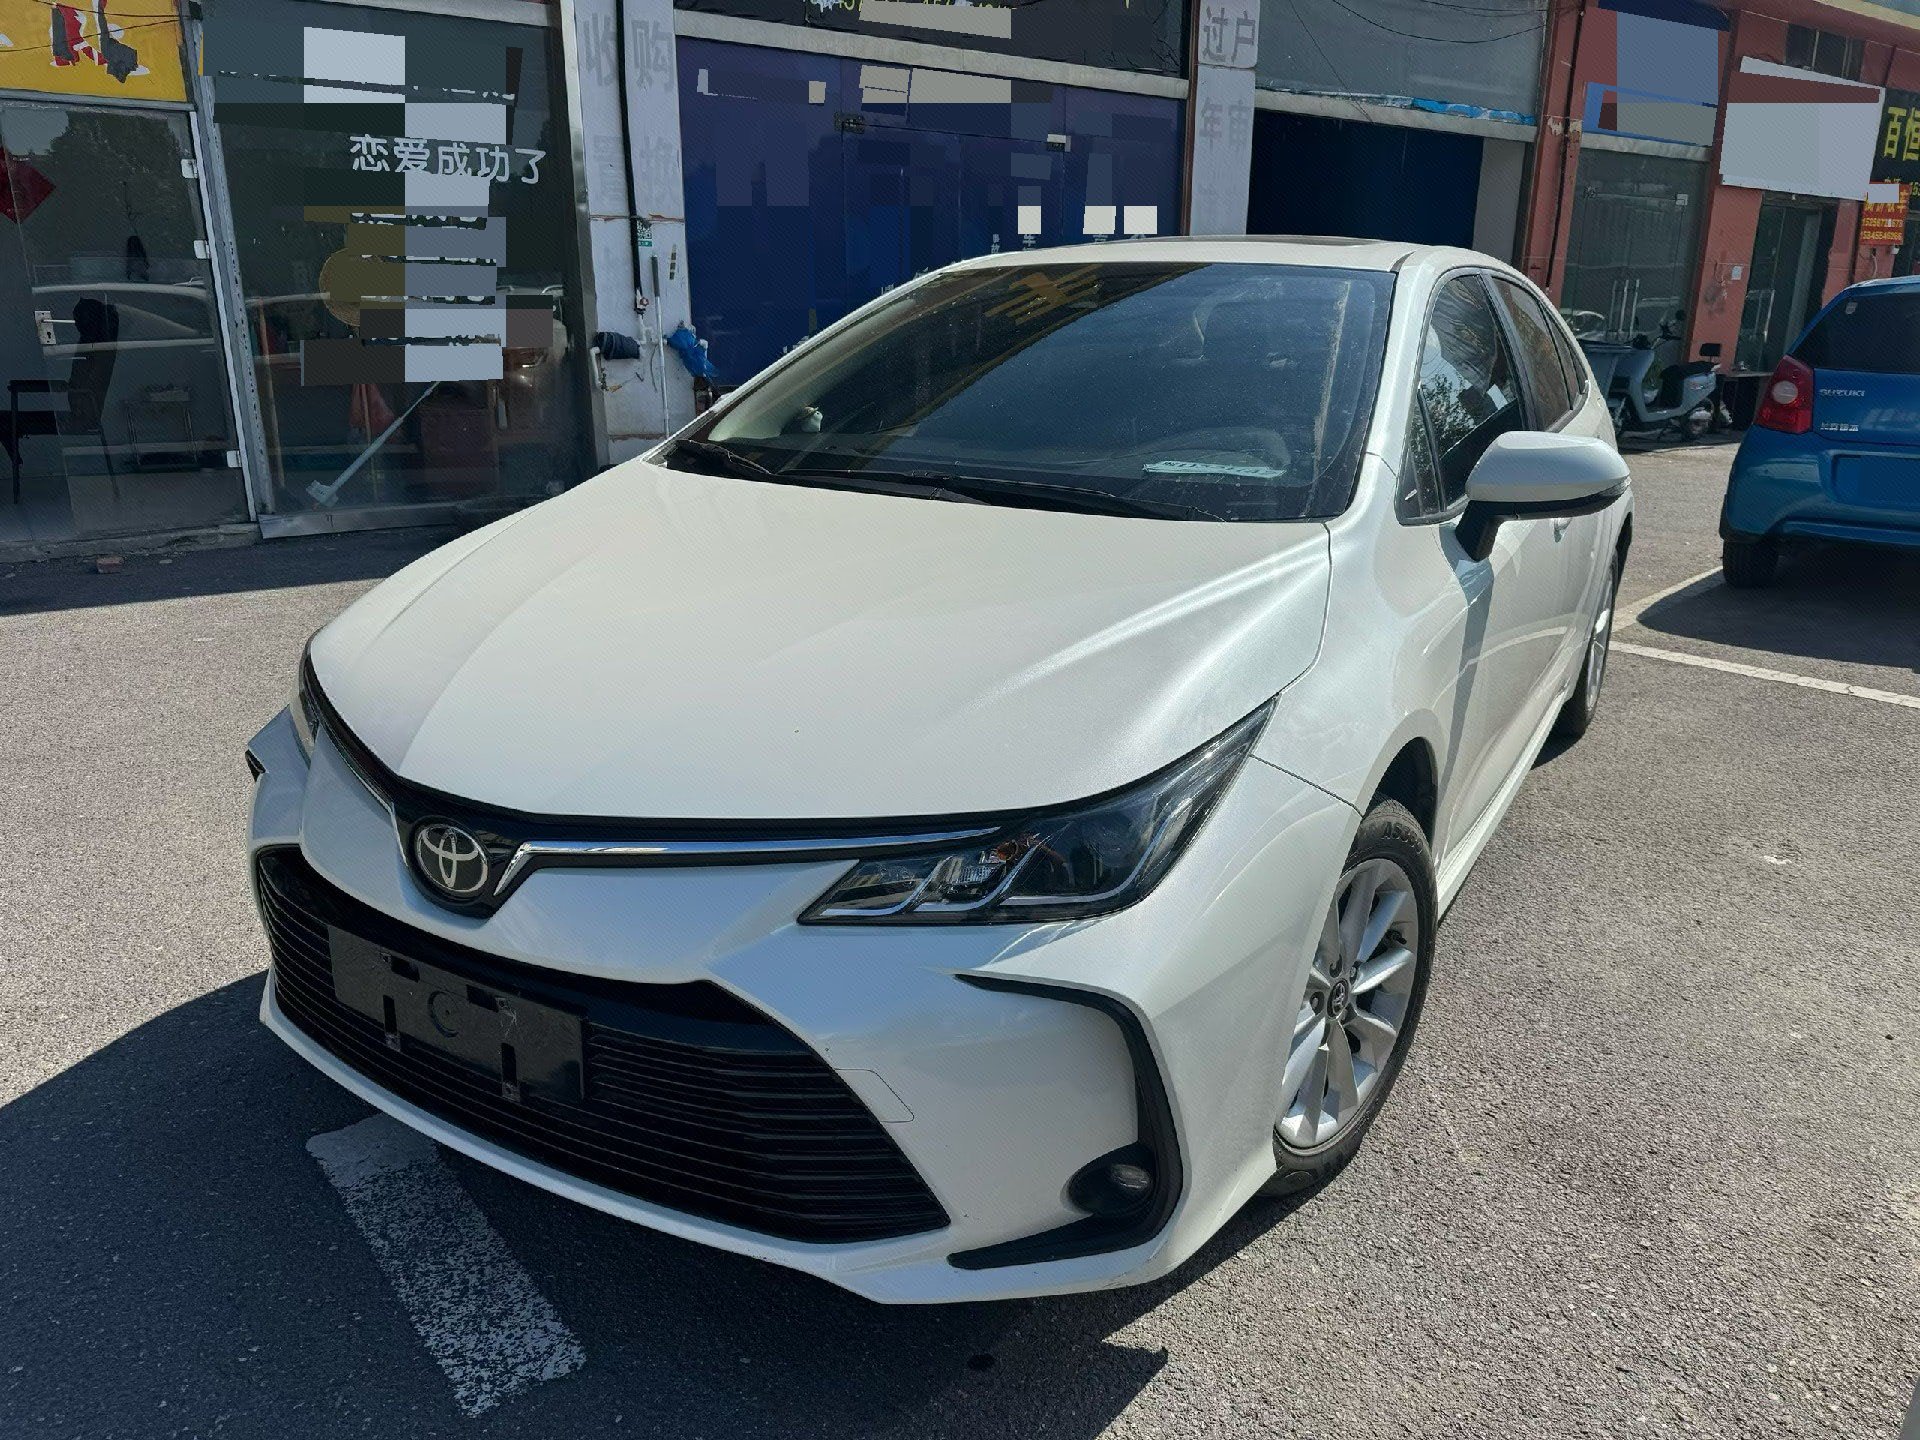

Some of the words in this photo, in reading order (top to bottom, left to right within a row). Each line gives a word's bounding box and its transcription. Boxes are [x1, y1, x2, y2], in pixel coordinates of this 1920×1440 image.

[583, 13, 674, 92] 收购
[1203, 7, 1256, 63] 过户
[350, 134, 546, 184] 恋爱成功了
